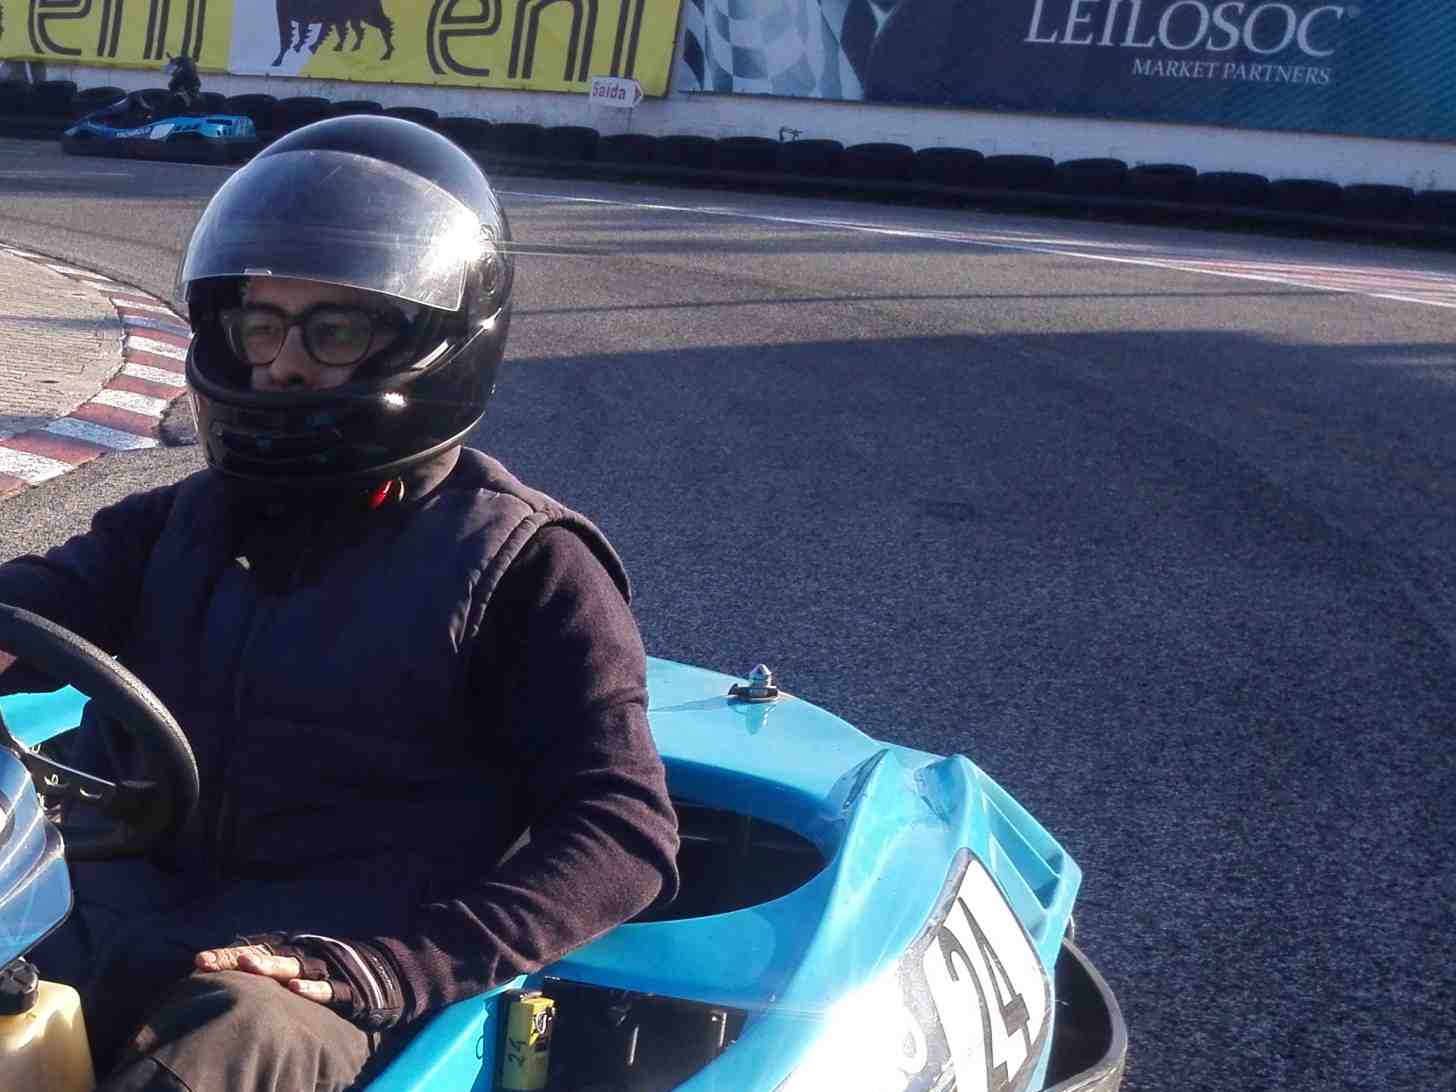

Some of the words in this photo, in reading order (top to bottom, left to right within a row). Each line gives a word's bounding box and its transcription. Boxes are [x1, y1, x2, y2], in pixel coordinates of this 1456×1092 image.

[426, 0, 644, 82] eni
[1024, 0, 1344, 57] LEILOSOC
[1131, 58, 1219, 79] MARKET
[1223, 63, 1333, 85] PARTNERS
